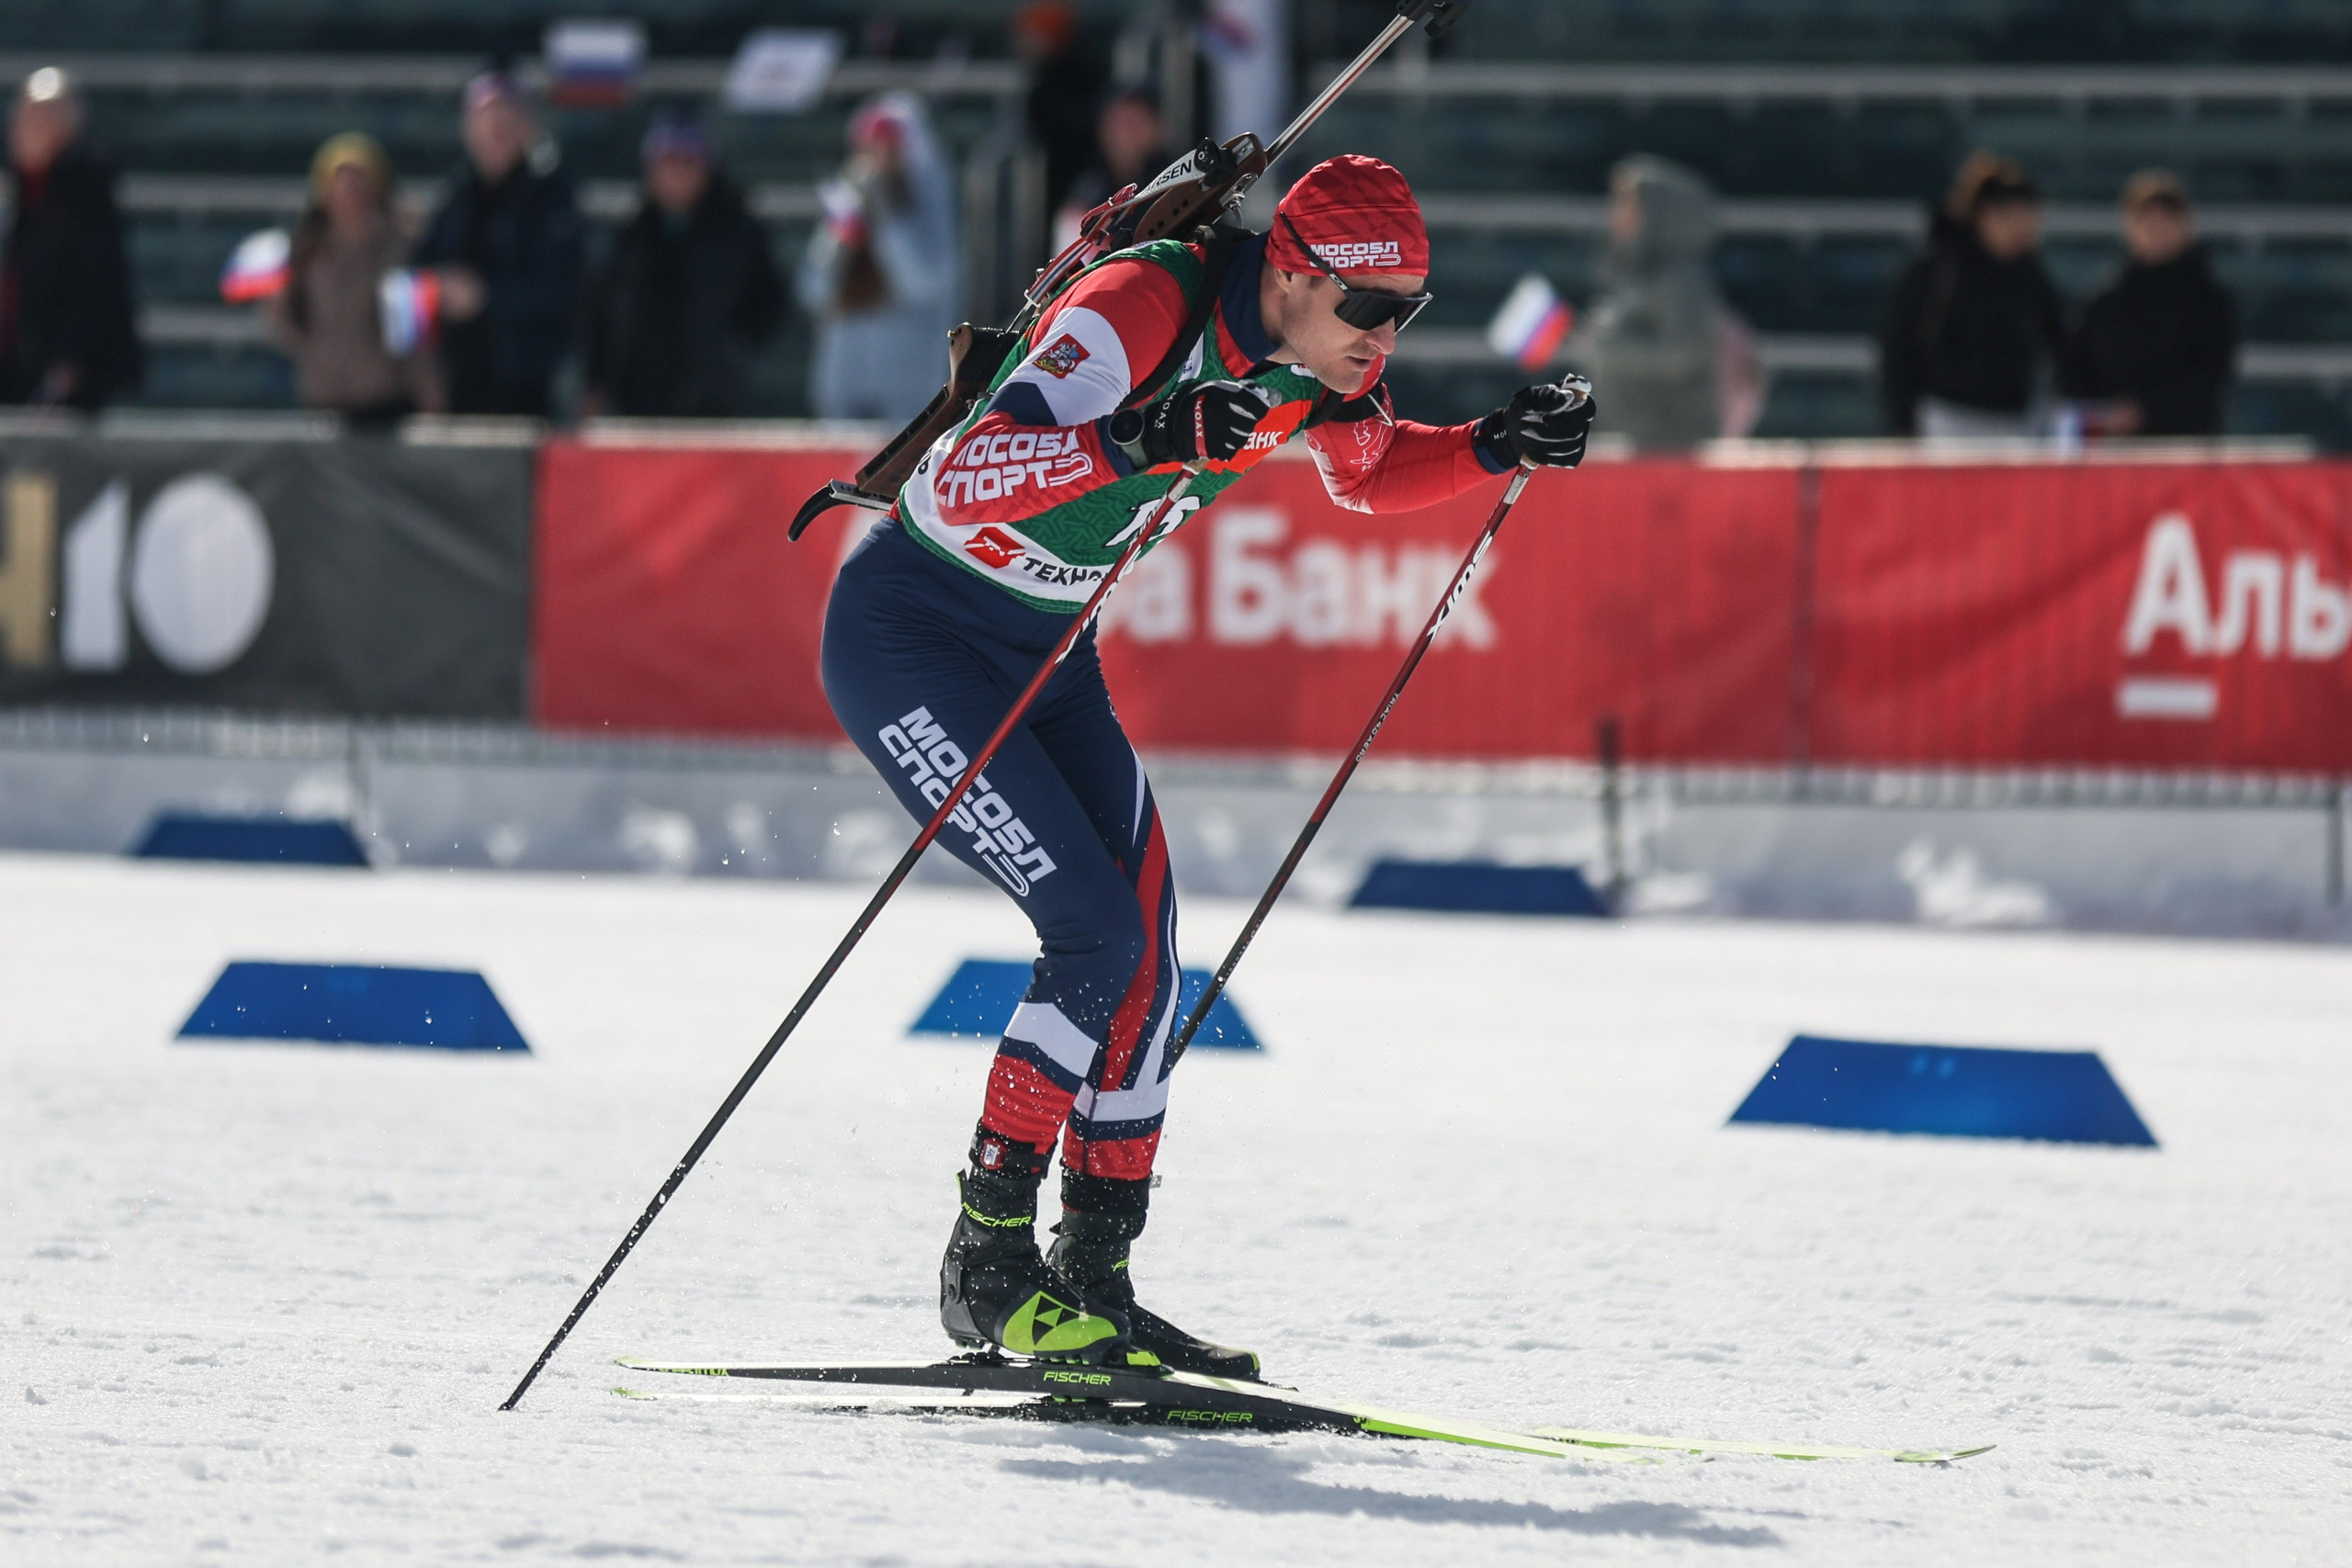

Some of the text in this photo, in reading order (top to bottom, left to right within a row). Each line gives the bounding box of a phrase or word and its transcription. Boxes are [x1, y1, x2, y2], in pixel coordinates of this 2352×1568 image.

[1158, 392, 1177, 429] MOAX
[1194, 400, 1204, 437] MOAX
[1209, 513, 1501, 649] Банк
[961, 1201, 1032, 1227] FISCHER
[1043, 1371, 1112, 1386] FISCHER
[1167, 1409, 1253, 1424] FISCHER
